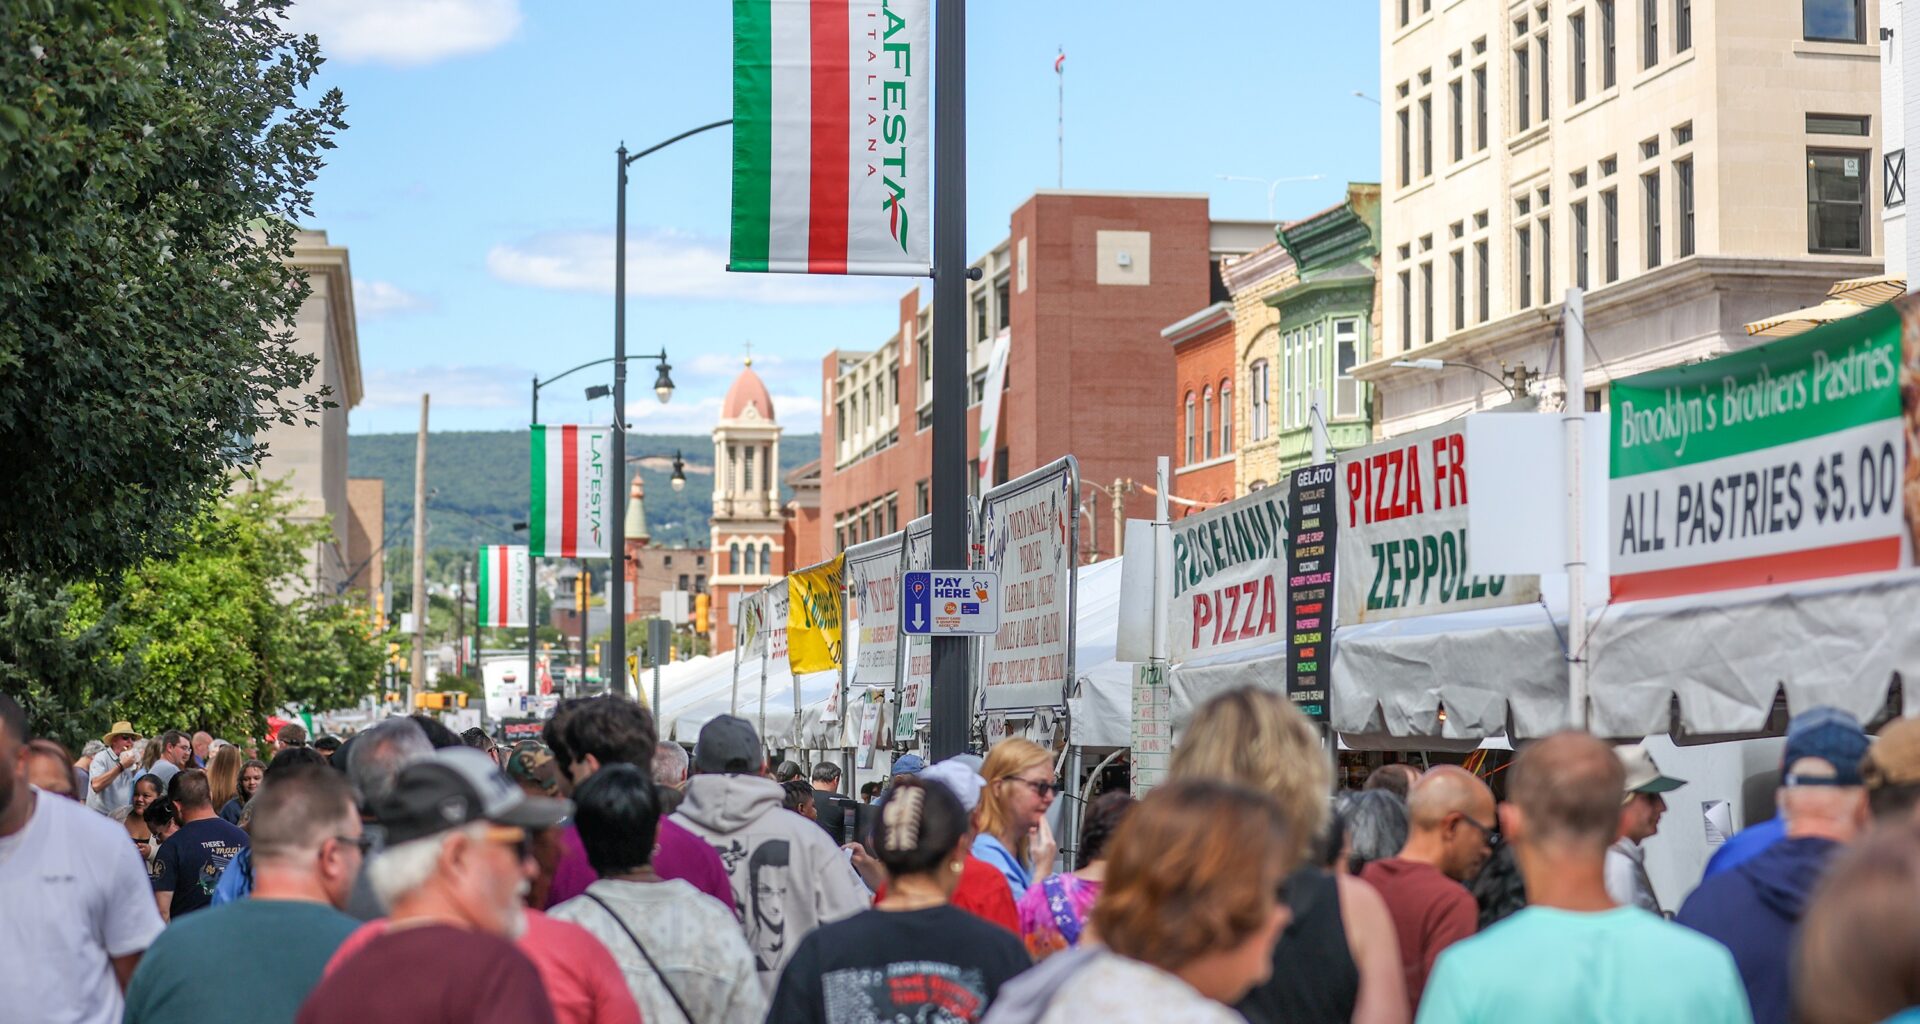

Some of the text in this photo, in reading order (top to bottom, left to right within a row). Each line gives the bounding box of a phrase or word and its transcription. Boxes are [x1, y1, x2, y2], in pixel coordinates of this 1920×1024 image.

[867, 14, 877, 177] ITALIANA
[882, 0, 911, 235] AFESTA
[1621, 338, 1895, 457] Brooklyn's Brothers Pastries
[591, 435, 603, 540] LAFESTA
[1297, 467, 1333, 487] GELATO
[1299, 489, 1325, 501] CHOCOLATE
[1347, 445, 1424, 528] PIZZA
[1619, 441, 1896, 555] ALL PASTRIES $5.00
[1301, 518, 1320, 530] BANANA
[1302, 503, 1320, 515] VANILLA
[935, 577, 962, 588] PAY
[935, 588, 971, 598] HERE
[1306, 572, 1331, 585] CHOCOLATE
[1367, 529, 1506, 611] ZEPPOL
[1192, 574, 1277, 650] PIZZA
[1141, 666, 1163, 685] PIZZA
